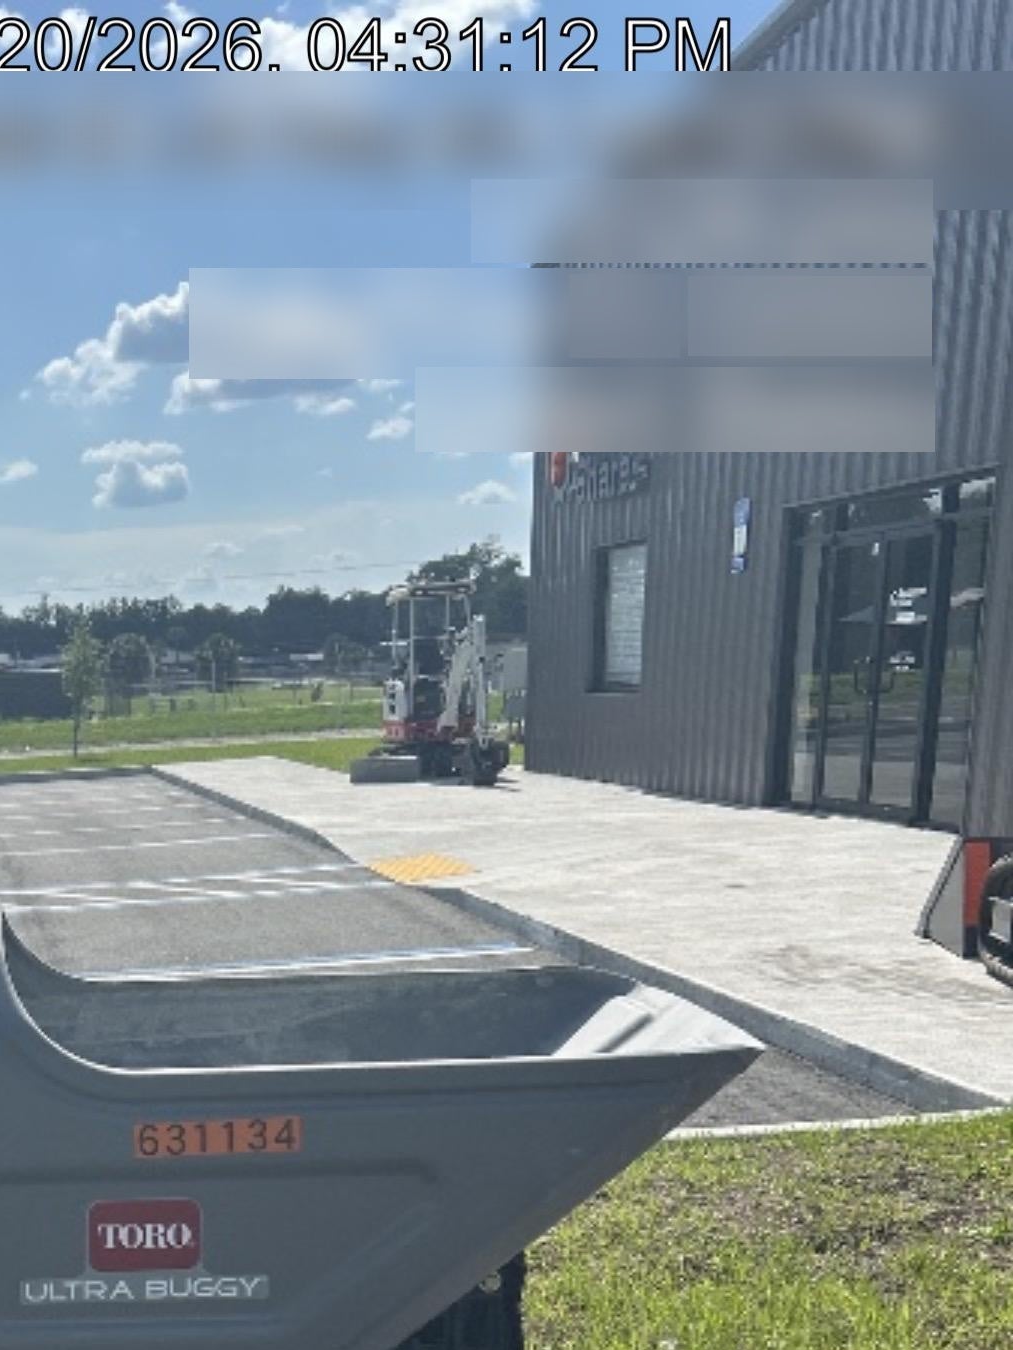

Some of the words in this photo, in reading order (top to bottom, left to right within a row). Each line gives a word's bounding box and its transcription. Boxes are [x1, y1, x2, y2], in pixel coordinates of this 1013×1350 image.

[138, 1118, 296, 1156] 631134
[97, 1223, 193, 1249] TORO
[24, 1280, 135, 1301] ULTRA
[145, 1277, 261, 1299] BUGGY
